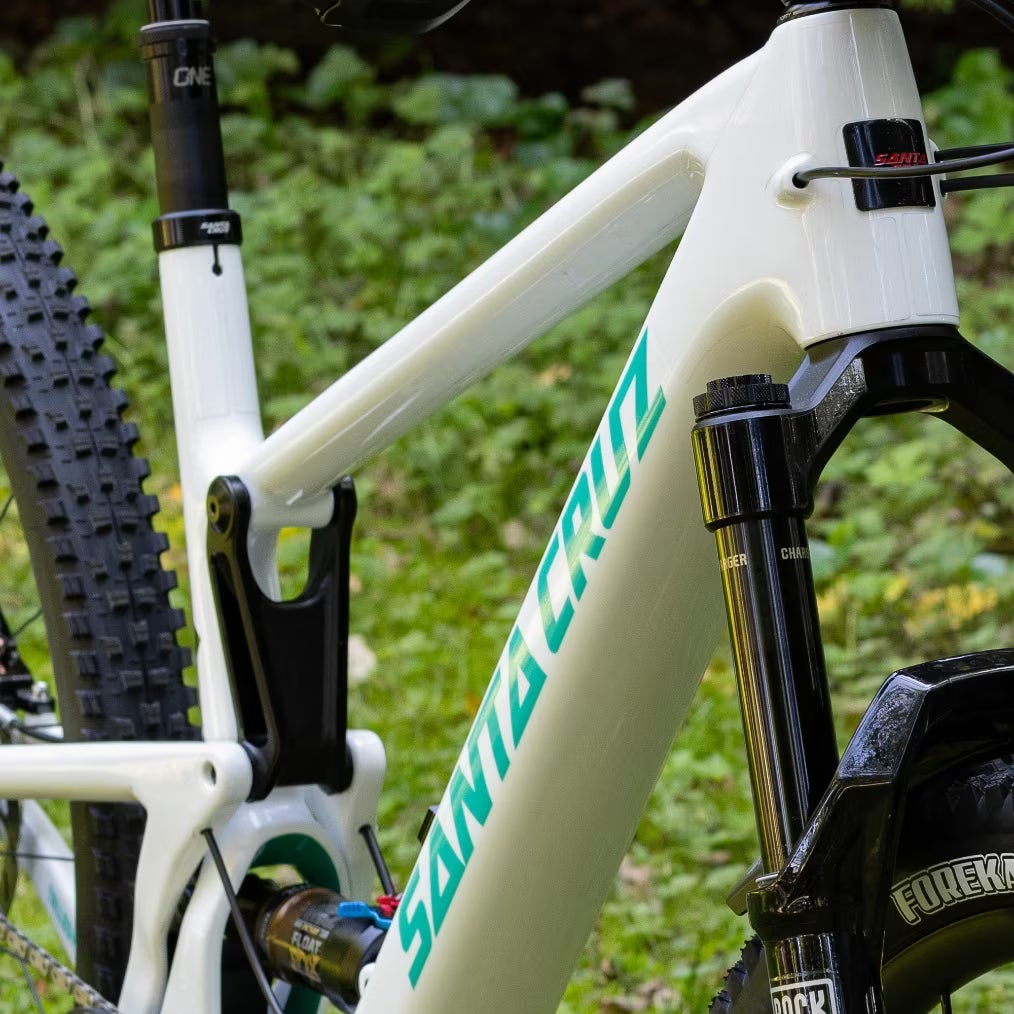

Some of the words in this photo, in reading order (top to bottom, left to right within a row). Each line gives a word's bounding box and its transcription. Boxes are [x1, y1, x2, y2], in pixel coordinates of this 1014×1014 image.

[173, 67, 212, 87] ONE
[874, 152, 927, 166] SANTA
[400, 625, 546, 989] SANTA
[538, 327, 666, 653] CRUZ
